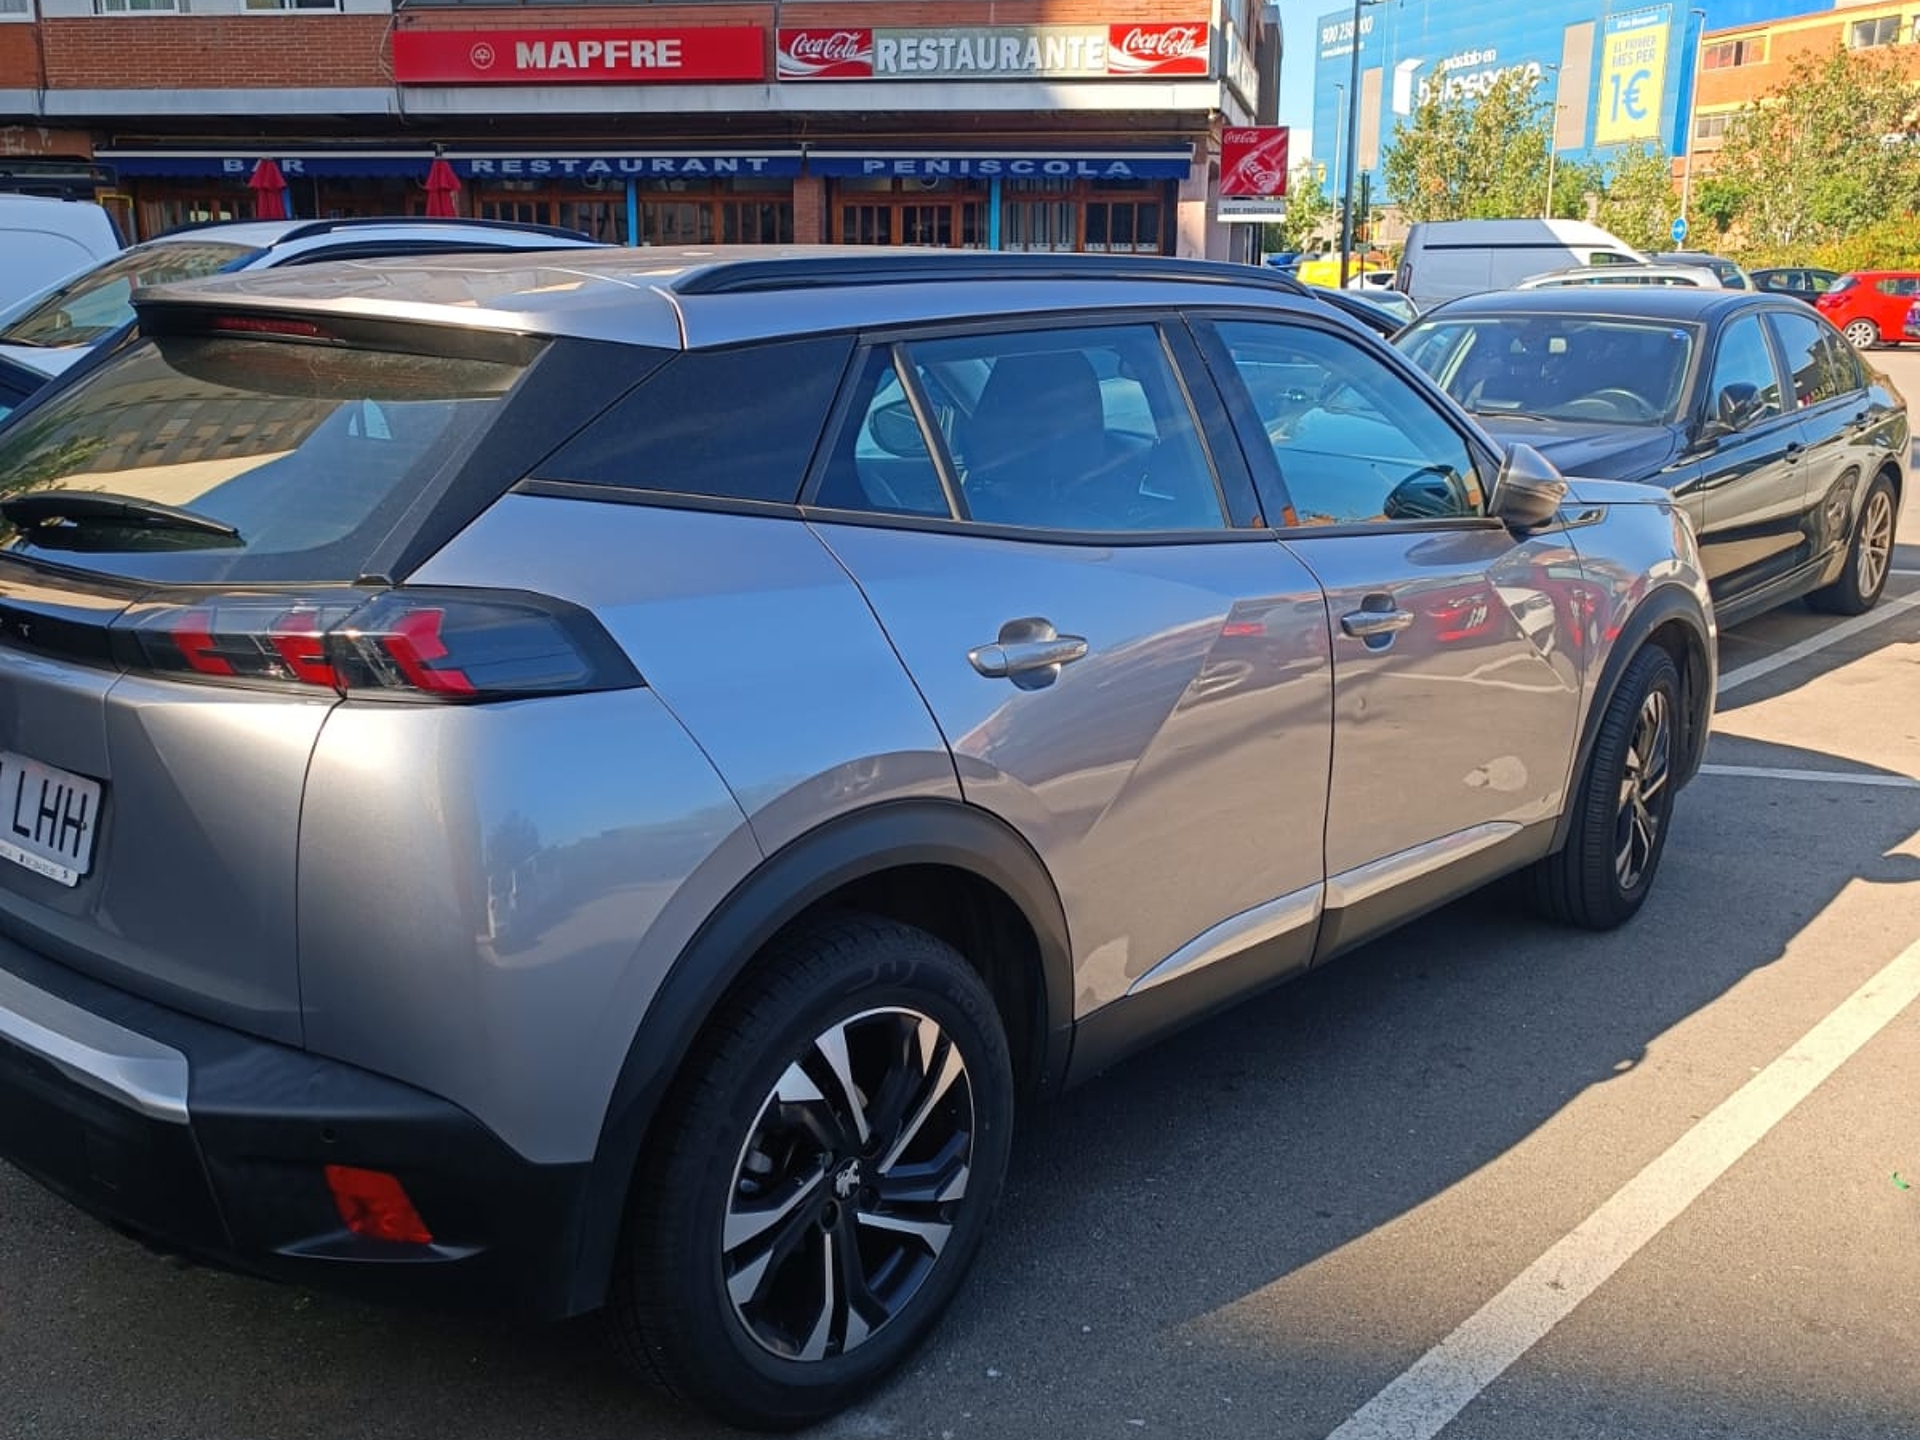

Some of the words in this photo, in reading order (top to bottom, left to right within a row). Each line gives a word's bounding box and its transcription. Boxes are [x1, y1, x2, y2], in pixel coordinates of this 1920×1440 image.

[515, 39, 682, 69] MAPFRE
[876, 36, 1106, 73] RESTAURANTE
[1611, 69, 1652, 122] 1€
[223, 159, 305, 173] BR
[471, 157, 769, 173] RESTAURANT
[13, 770, 88, 858] LHH
